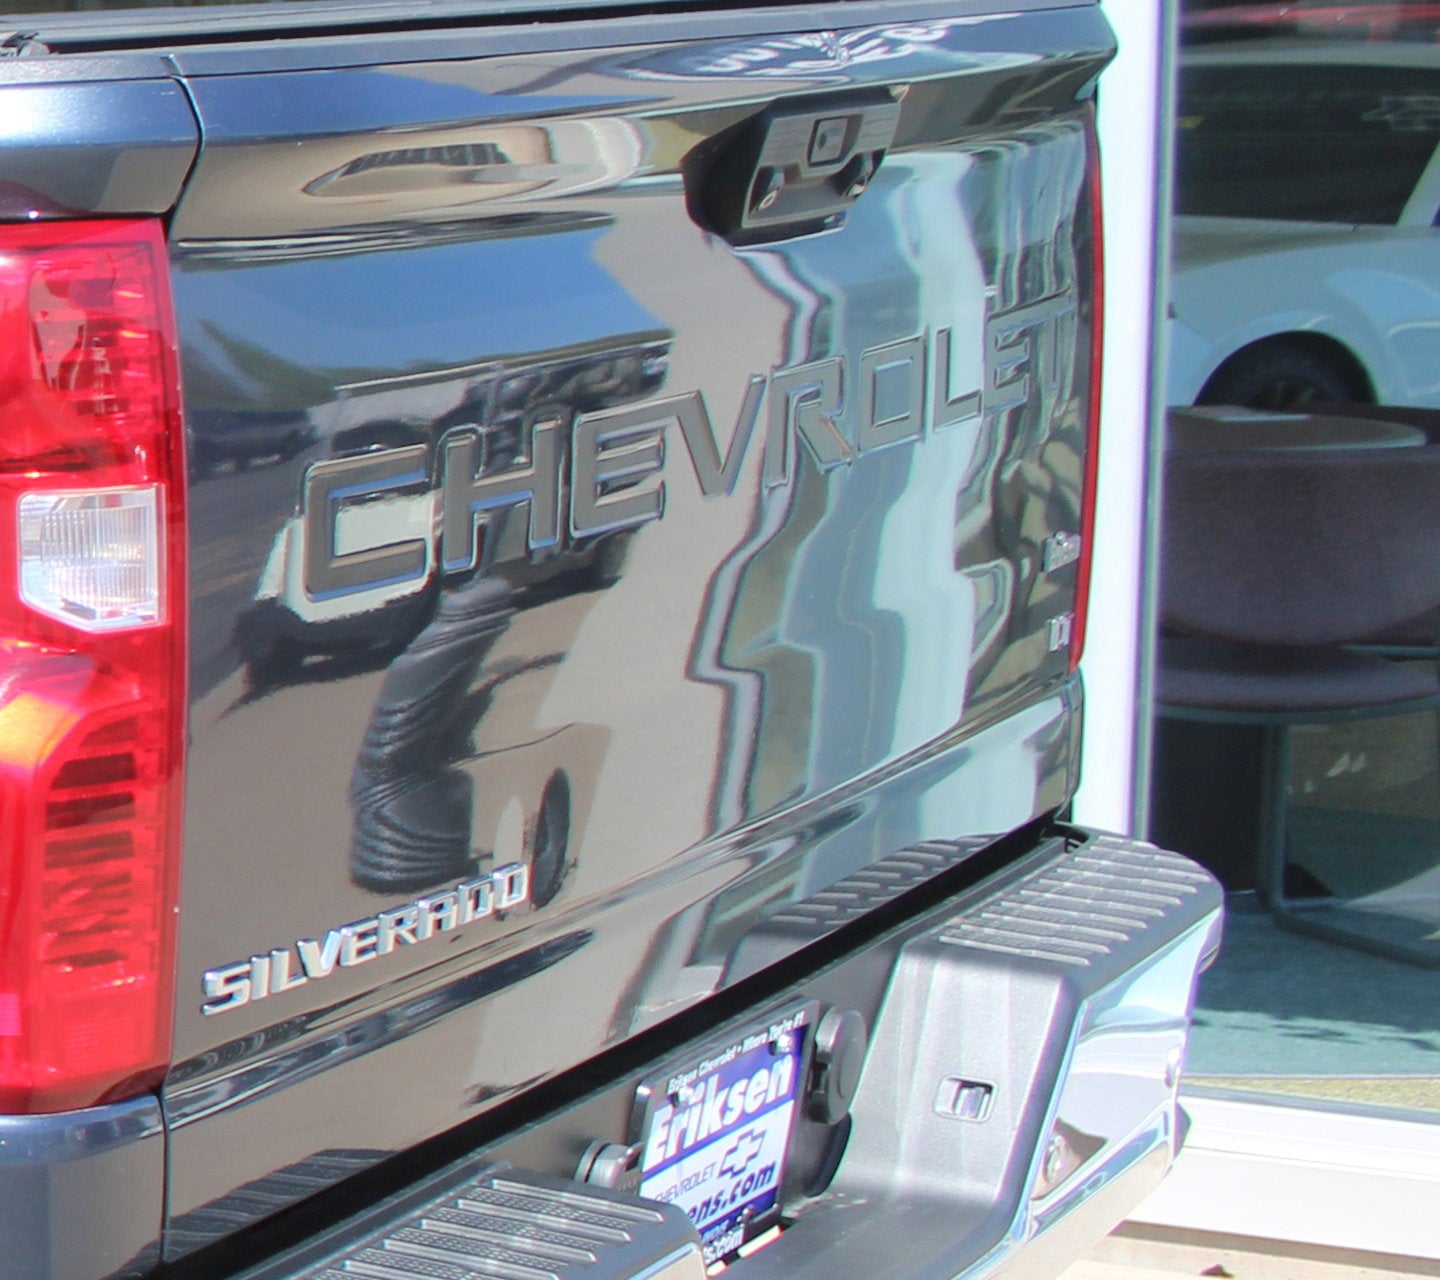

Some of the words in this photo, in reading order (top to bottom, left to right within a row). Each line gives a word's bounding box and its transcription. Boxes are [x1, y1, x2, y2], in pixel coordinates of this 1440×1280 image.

[301, 310, 1077, 604] CHEVROLET
[200, 860, 530, 1017] SILVERADO
[647, 1053, 796, 1166] Eriksen
